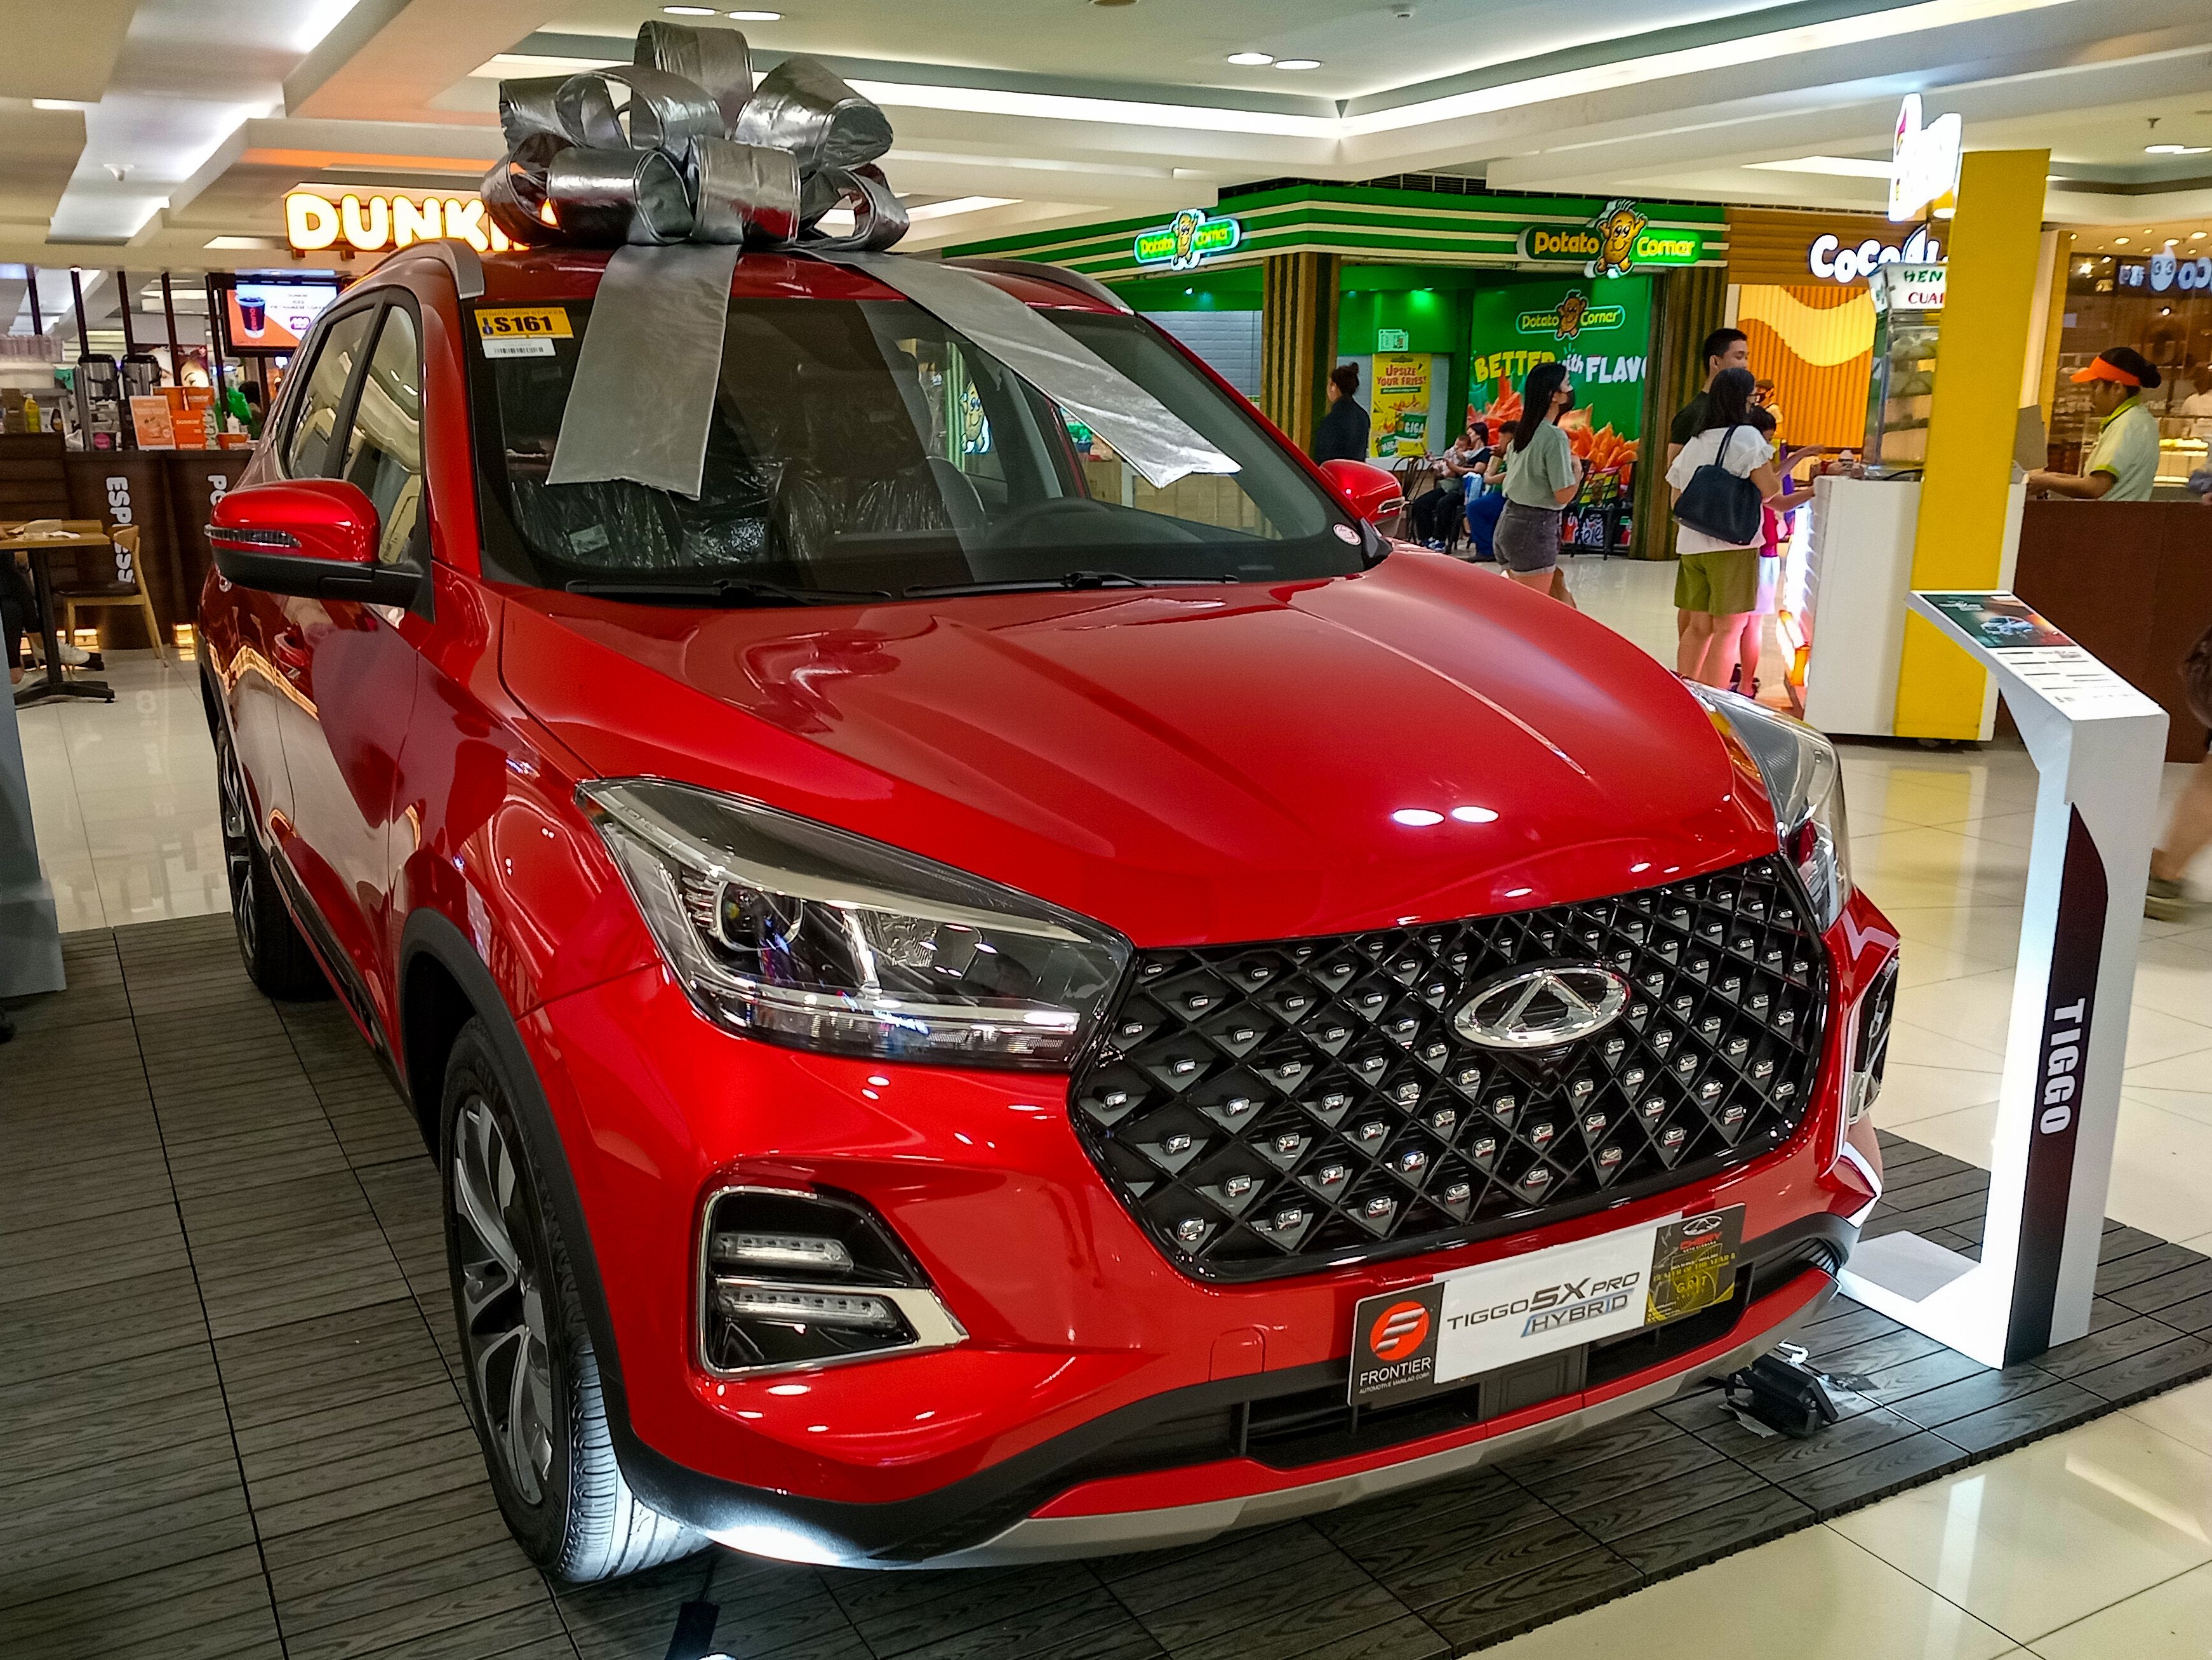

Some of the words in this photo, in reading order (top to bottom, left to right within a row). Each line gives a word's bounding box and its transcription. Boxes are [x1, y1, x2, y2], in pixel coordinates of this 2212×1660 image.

[1534, 231, 1599, 255] Potato
[1637, 236, 1695, 257] Corner
[493, 316, 553, 332] S161
[1522, 315, 1560, 330] Potato
[1580, 310, 1618, 326] Corner
[1376, 376, 1398, 386] YOUR
[2039, 998, 2086, 1134] TIGGO
[1447, 1299, 1529, 1330] TIGGO
[1529, 1277, 1591, 1313] 5X
[1590, 1271, 1640, 1297] PRO
[1531, 1294, 1629, 1334] HYBRID
[1359, 1356, 1432, 1387] FRONTIER
